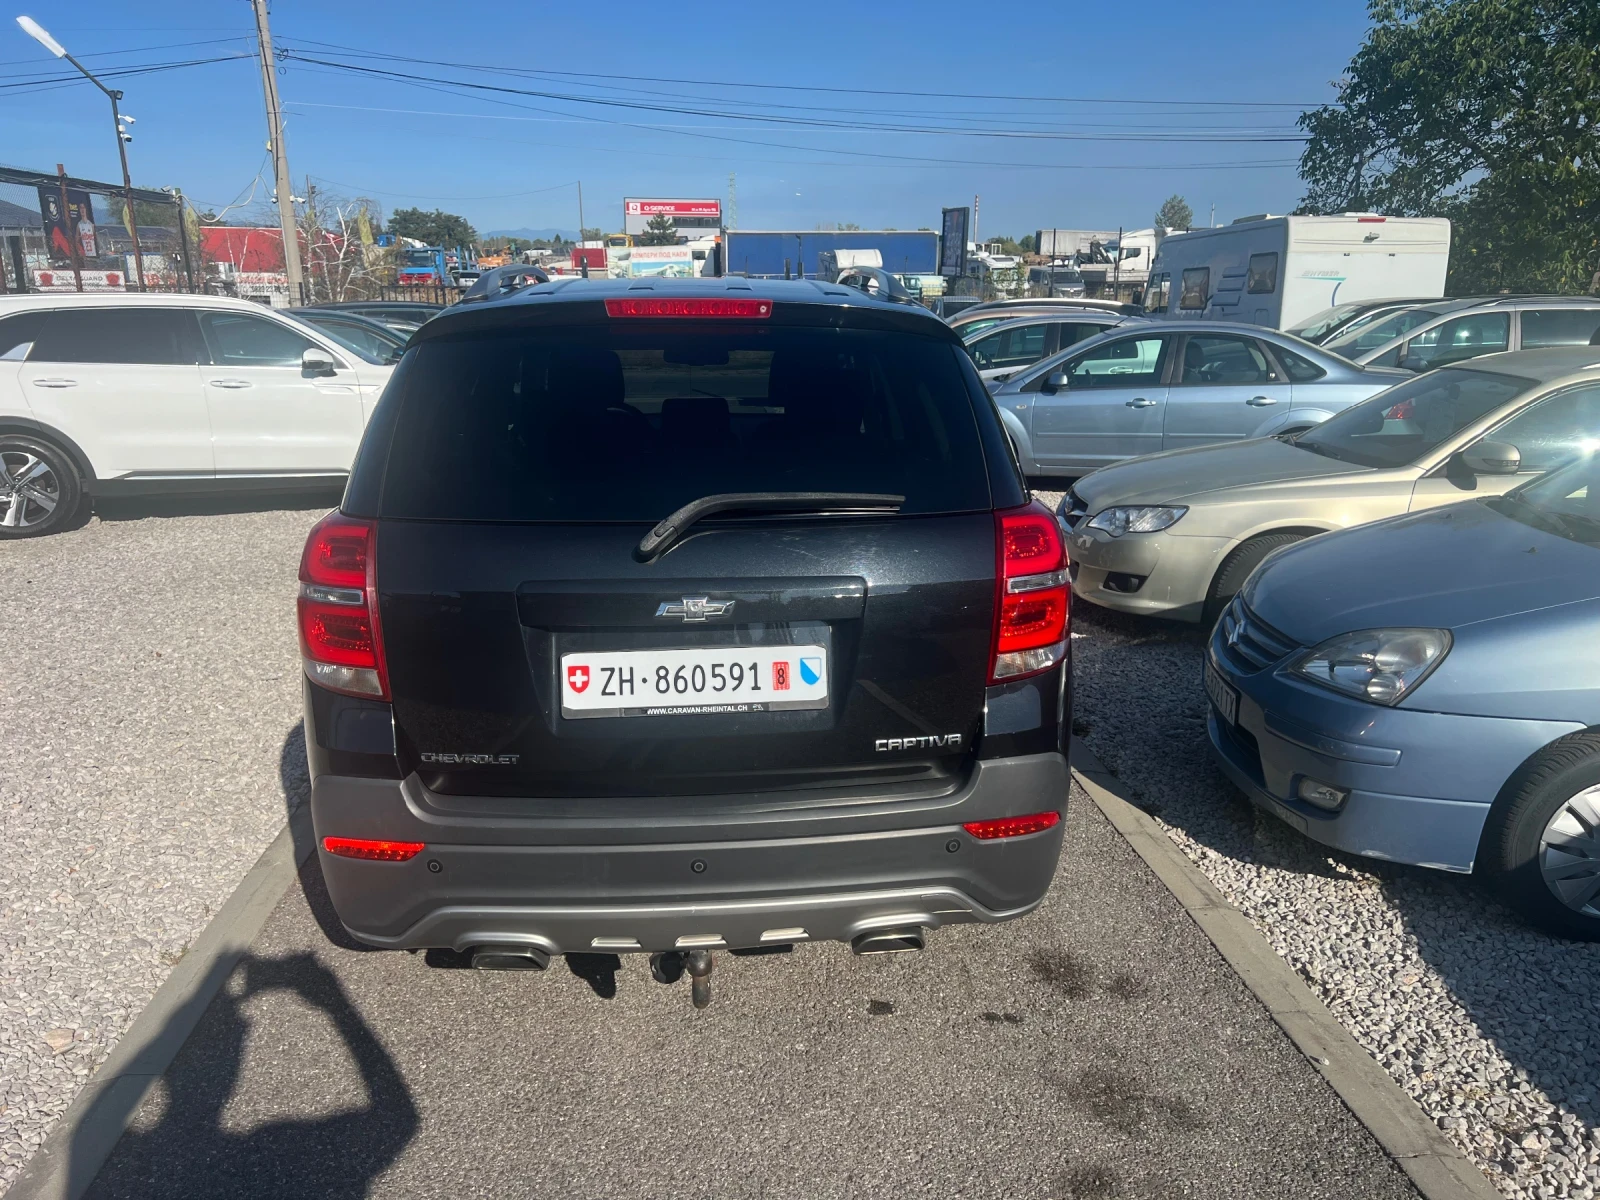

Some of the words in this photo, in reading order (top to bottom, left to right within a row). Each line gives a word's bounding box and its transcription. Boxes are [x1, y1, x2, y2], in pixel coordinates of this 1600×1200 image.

[777, 668, 785, 685] 8
[647, 704, 748, 715] WWW.CARAVAN-RHEINTAL.CH
[875, 734, 961, 752] CAPTIVA
[421, 752, 519, 764] CHEVROLET
